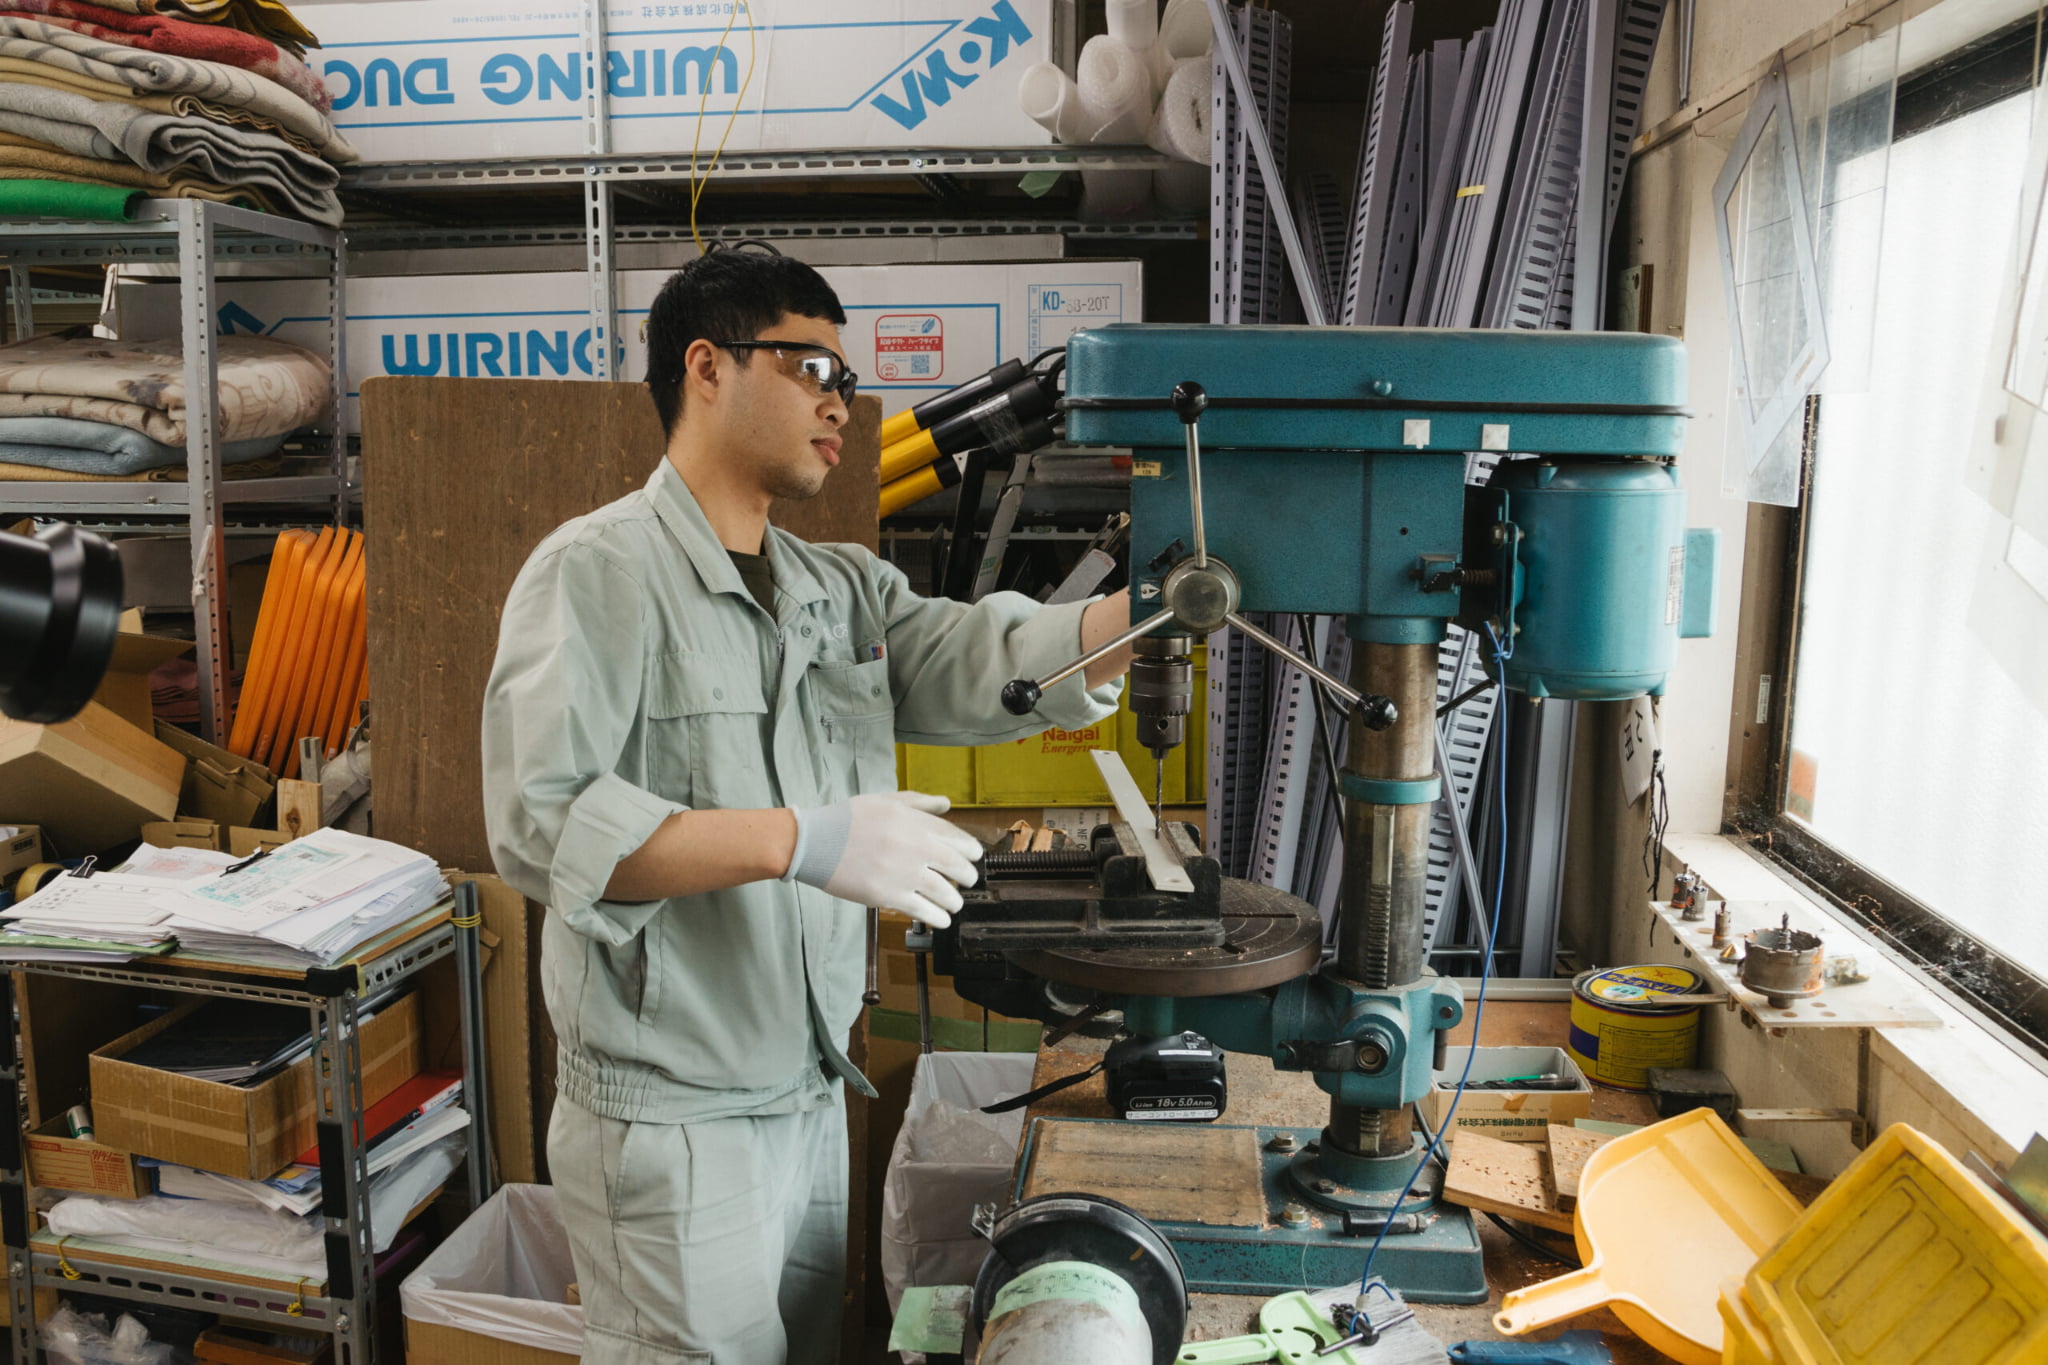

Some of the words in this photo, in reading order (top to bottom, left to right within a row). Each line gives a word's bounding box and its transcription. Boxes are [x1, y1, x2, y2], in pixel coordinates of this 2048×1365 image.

[306, 57, 455, 110] DUC
[480, 46, 738, 105] WIRNG
[870, 1, 1033, 130] KOWA
